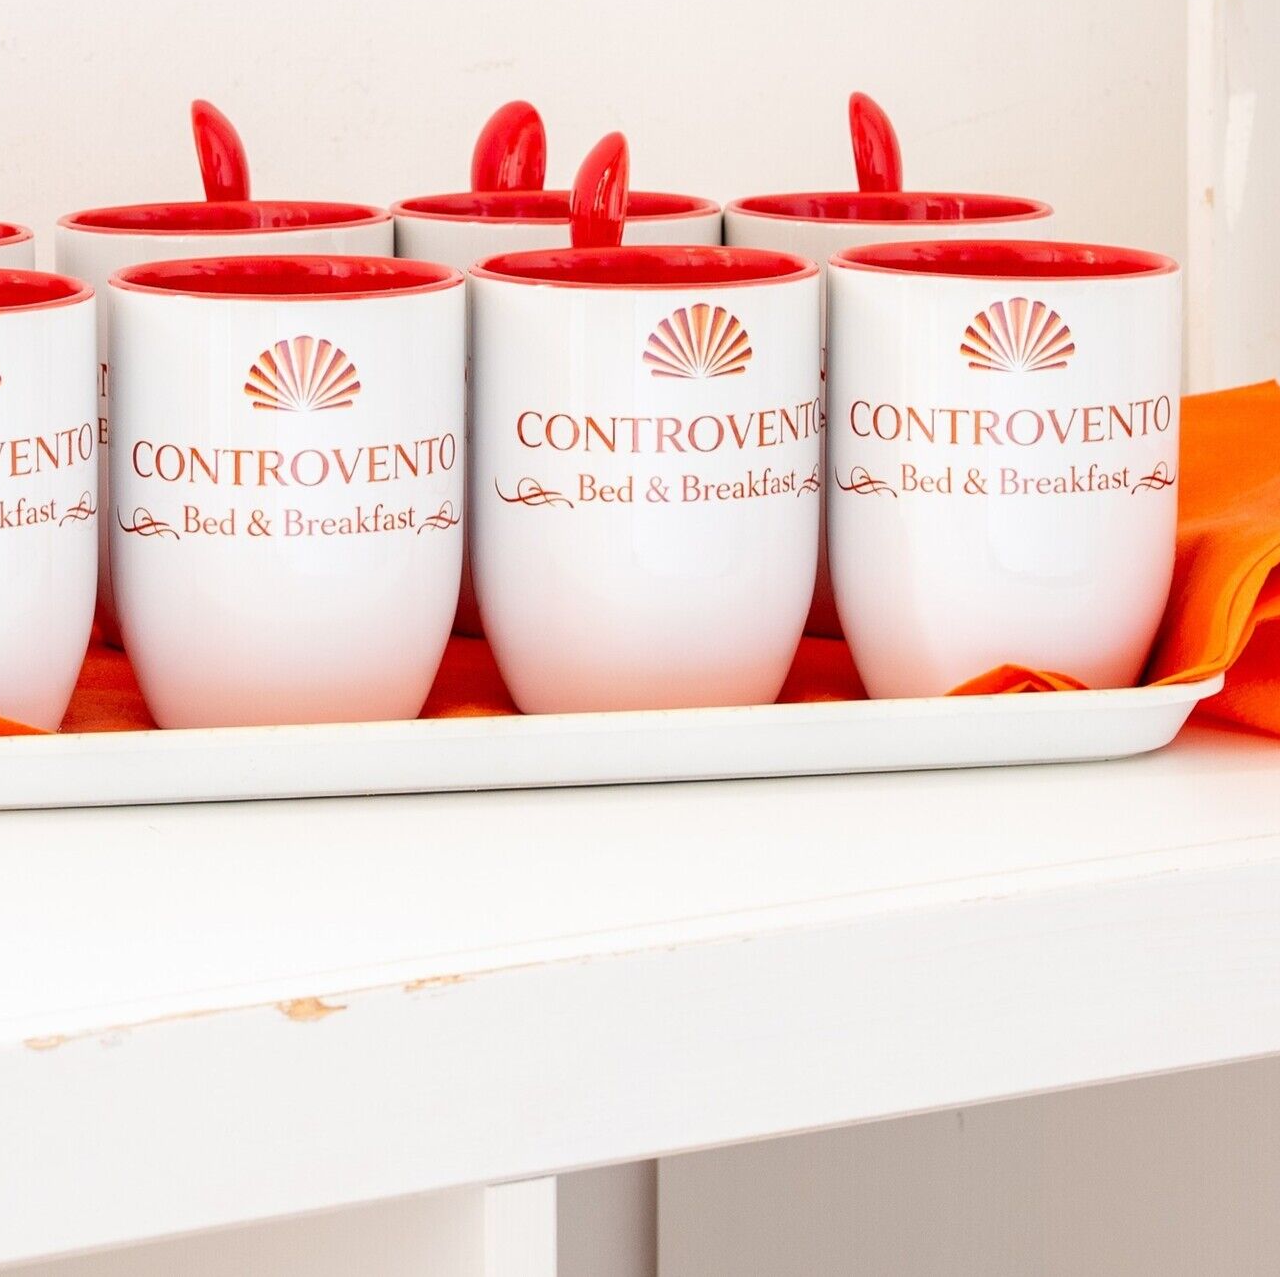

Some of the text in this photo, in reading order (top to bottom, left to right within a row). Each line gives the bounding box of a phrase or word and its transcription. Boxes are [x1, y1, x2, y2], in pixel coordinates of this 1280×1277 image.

[516, 396, 821, 456] CONTROVENTO
[849, 394, 1171, 448] CONTROVENTO
[132, 432, 456, 488] CONTROVENTO
[901, 464, 1132, 495] Bed & Breakfast
[578, 465, 797, 504] Bed & Breakfast
[183, 504, 416, 538] Bed & Breakfast
